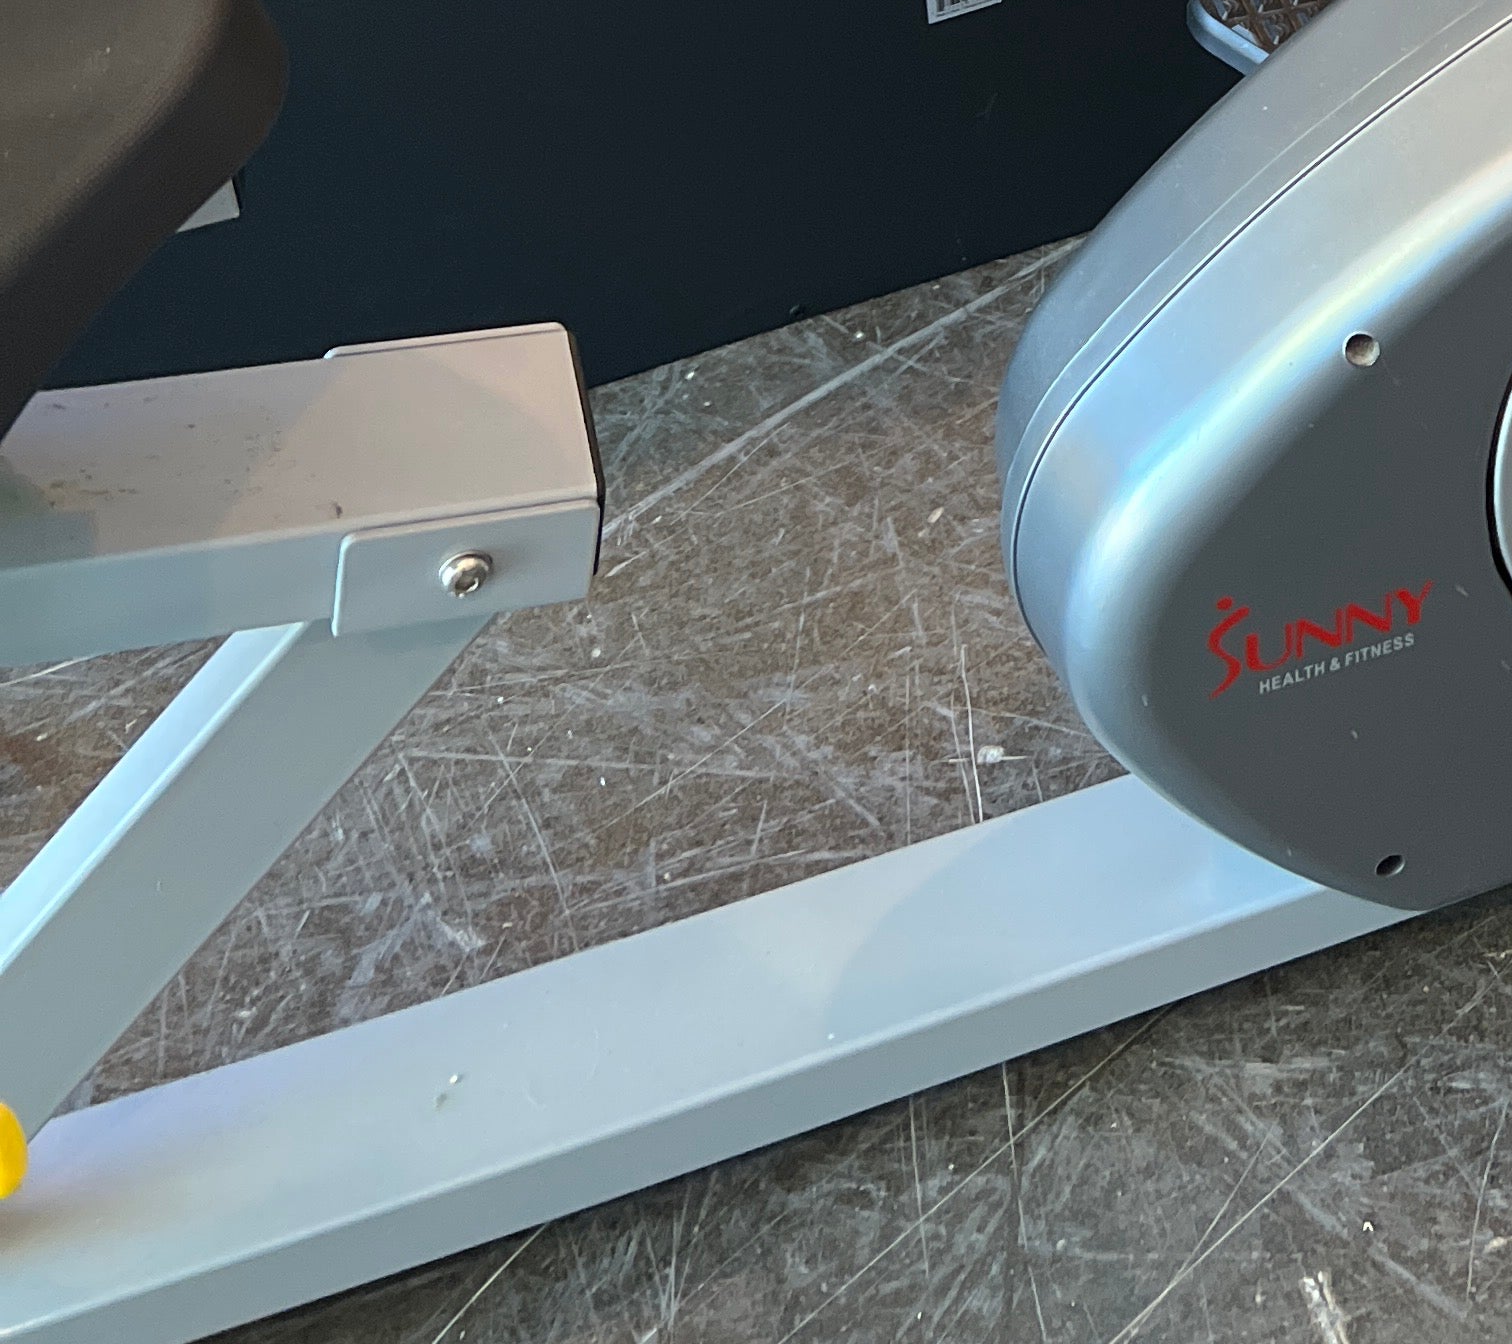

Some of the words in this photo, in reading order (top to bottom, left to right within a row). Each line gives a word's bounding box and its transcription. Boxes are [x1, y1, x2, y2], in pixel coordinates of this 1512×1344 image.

[1206, 578, 1435, 701] SUNNY
[1258, 661, 1326, 695] HEALTH
[1328, 656, 1342, 672] &
[1344, 632, 1416, 667] FITNESS
